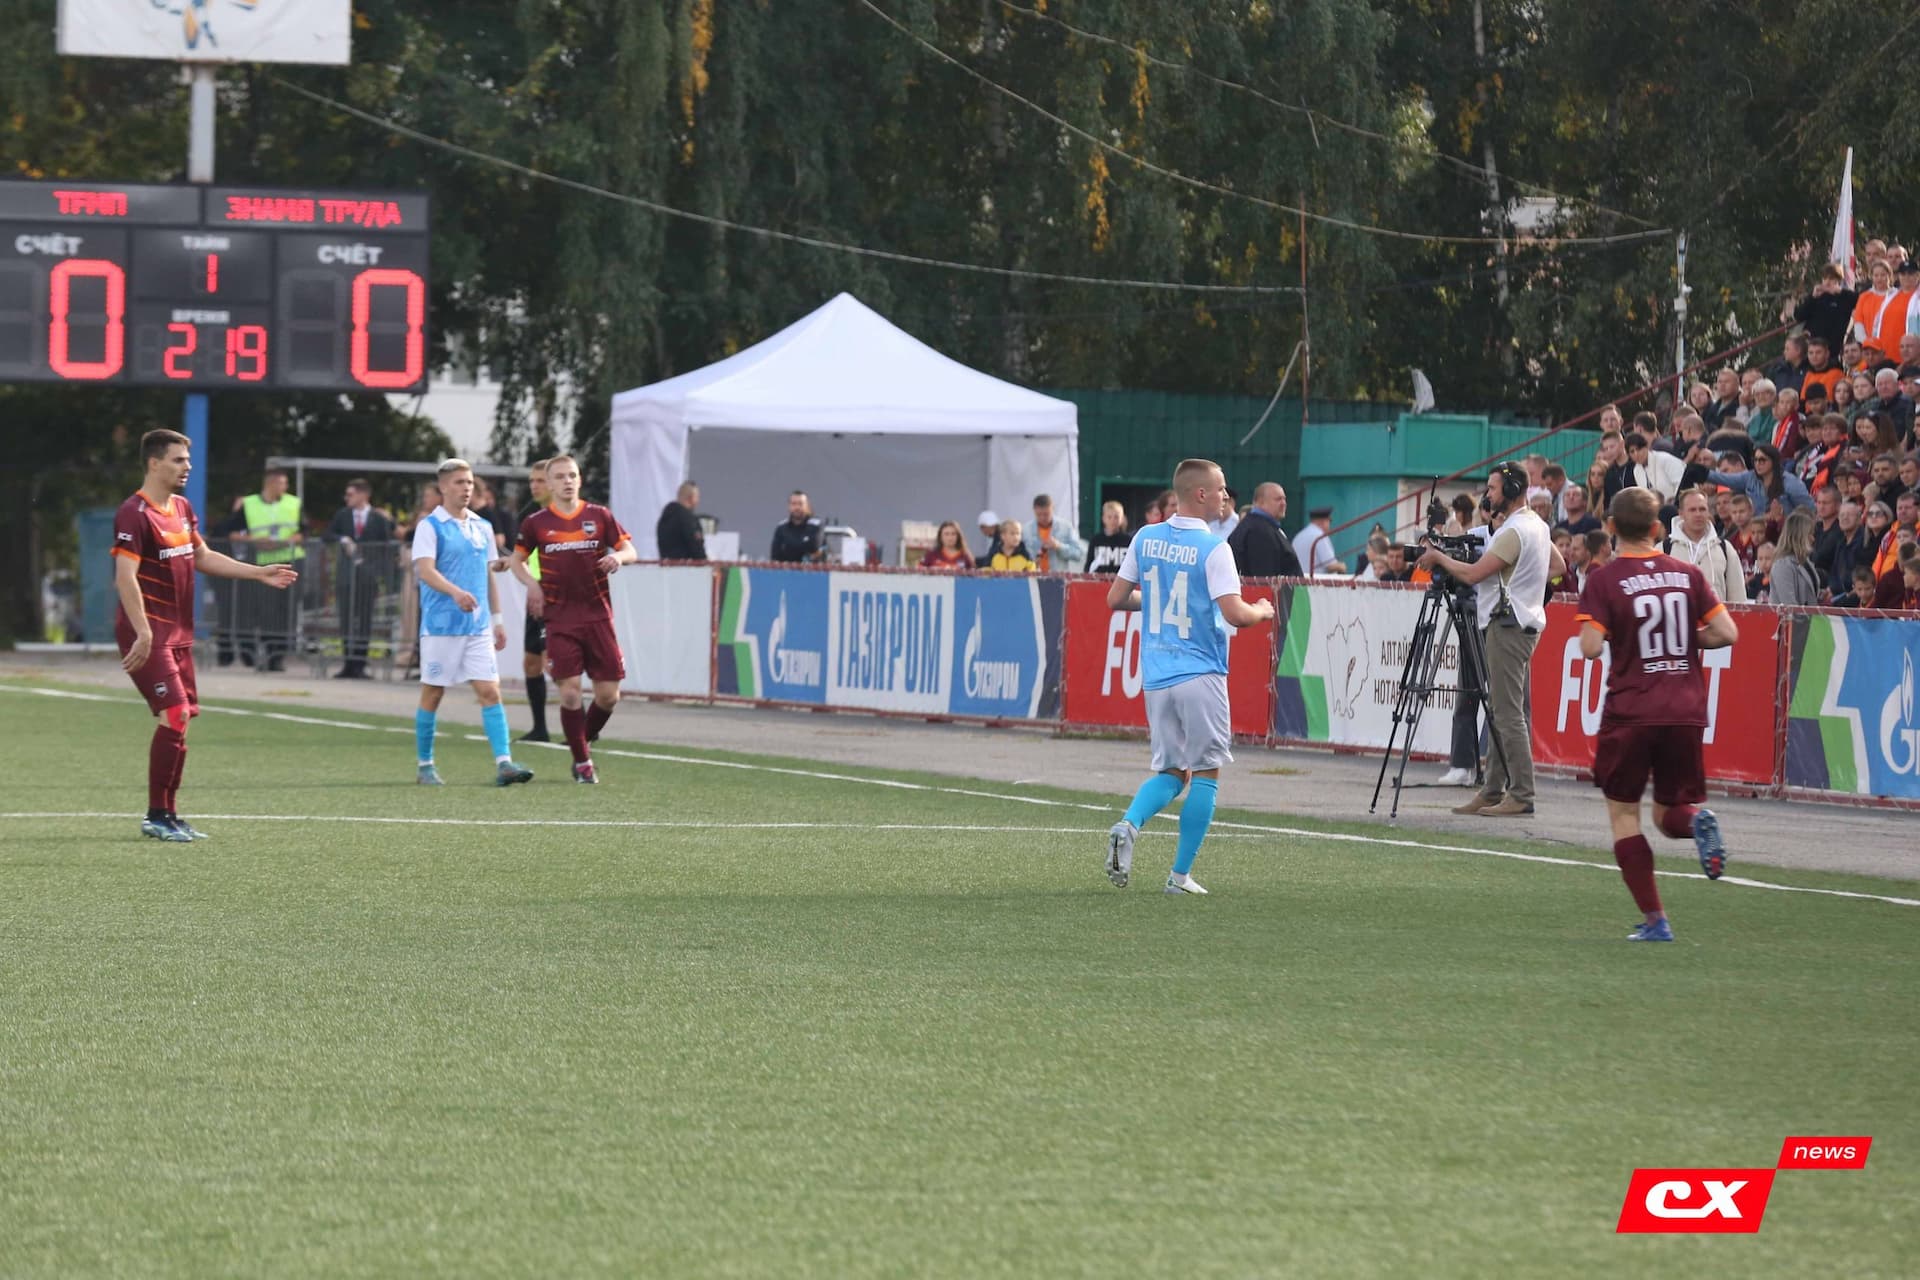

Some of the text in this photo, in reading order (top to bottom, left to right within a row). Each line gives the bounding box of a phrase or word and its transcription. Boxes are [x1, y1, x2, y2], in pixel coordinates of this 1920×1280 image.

[14, 232, 84, 256] СЧЁТ
[318, 199, 402, 228] ТРУДА
[206, 253, 218, 293] 1
[316, 243, 383, 265] СЧЁТ
[48, 259, 126, 380] 0
[351, 269, 425, 388] 0
[1143, 565, 1192, 640] 14
[1633, 592, 1689, 660] 20
[837, 590, 943, 695] ГАЗПРОМ
